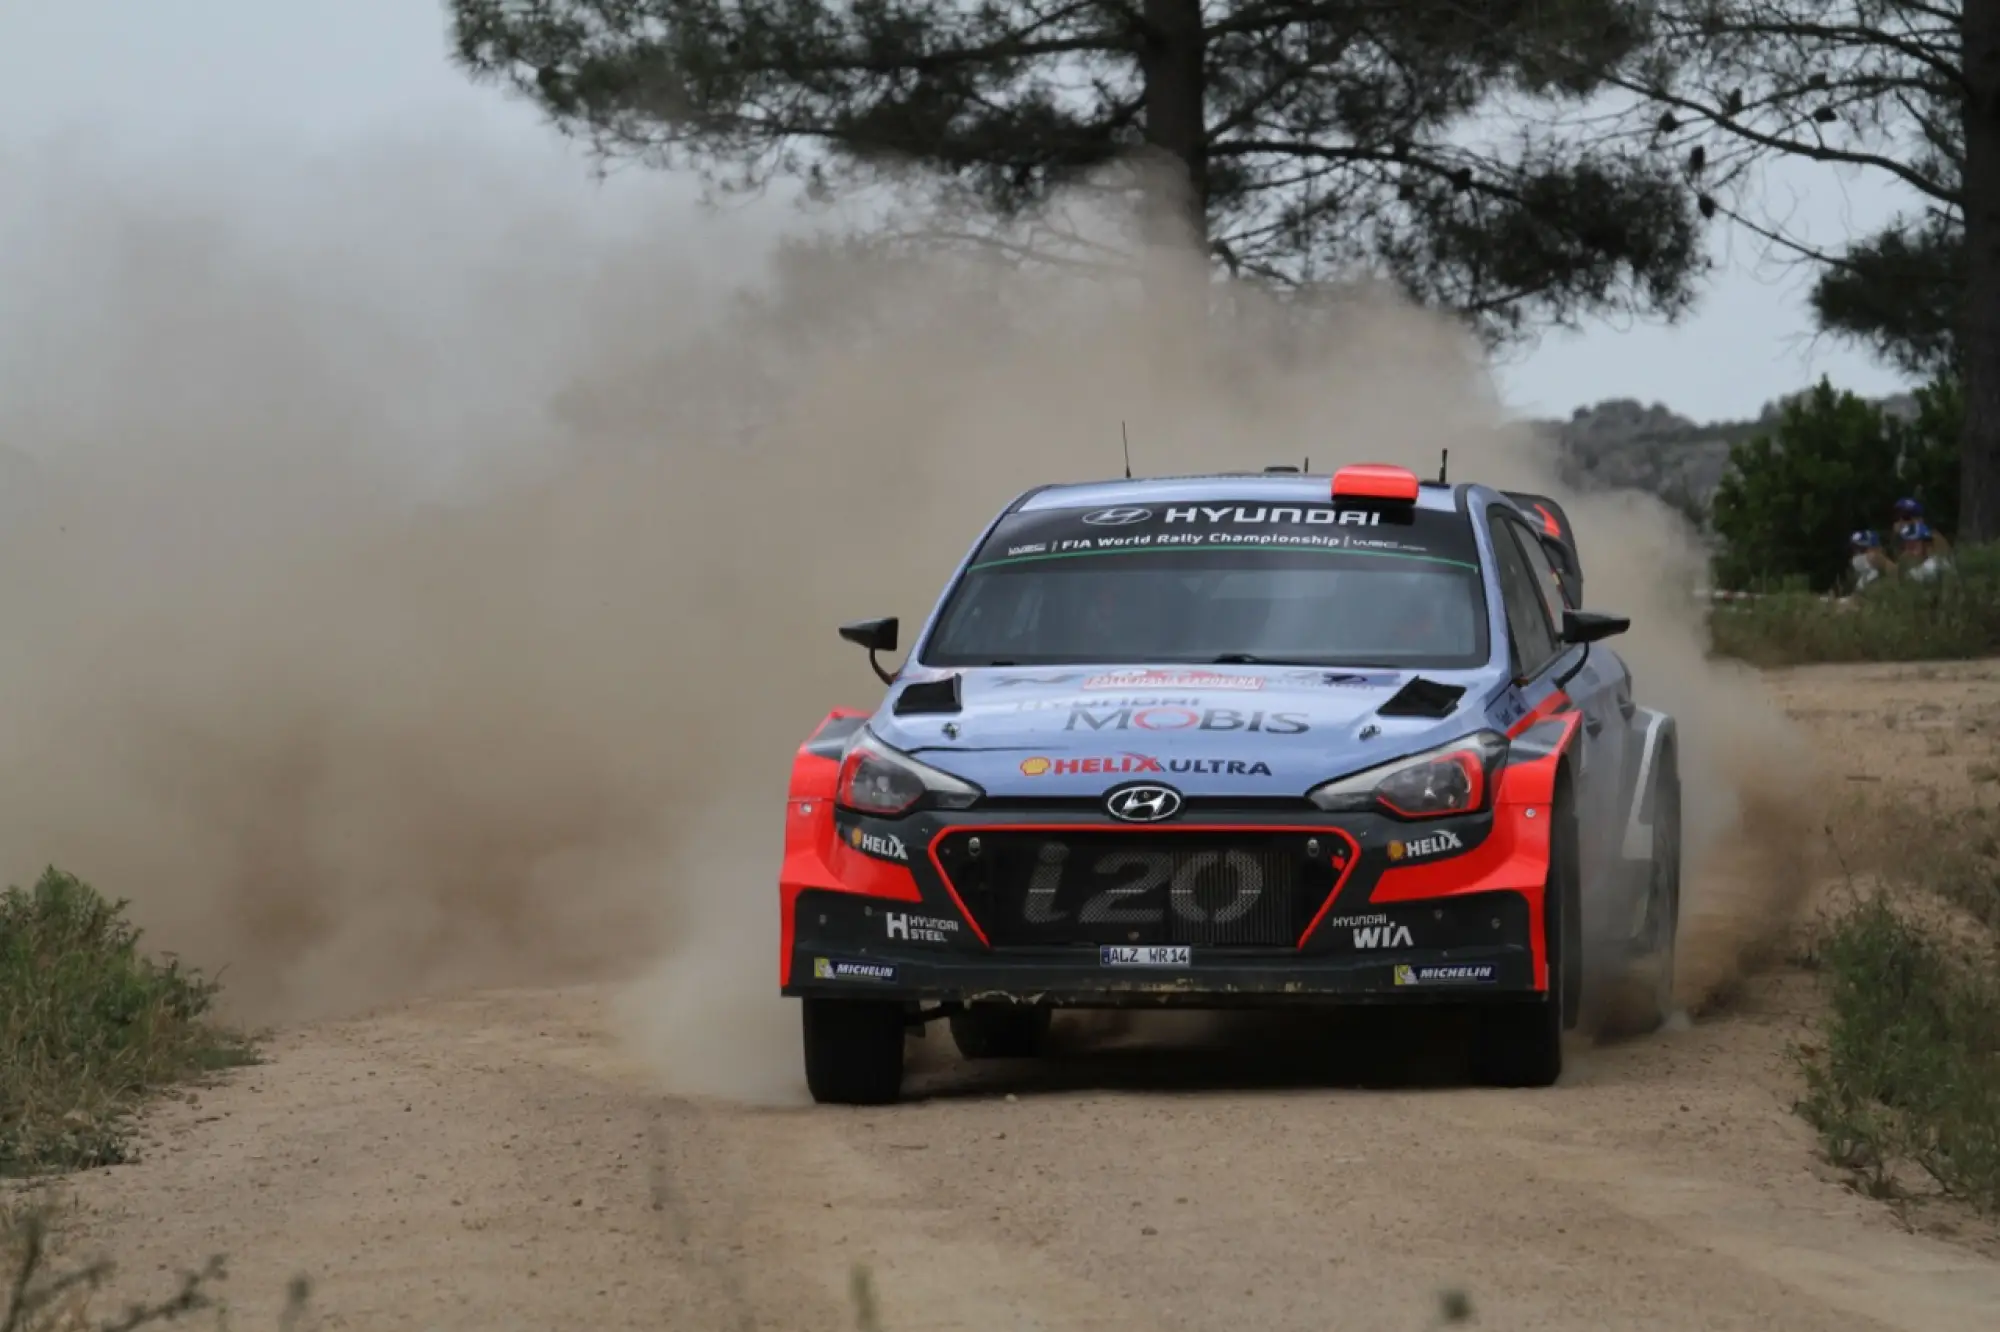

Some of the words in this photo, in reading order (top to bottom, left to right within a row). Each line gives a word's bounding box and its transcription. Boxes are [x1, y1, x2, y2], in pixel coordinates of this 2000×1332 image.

[1164, 506, 1381, 526] HYUNDAI
[1061, 539, 1092, 550] FIA
[1097, 534, 1152, 548] World
[1156, 533, 1204, 545] Rally
[1208, 532, 1341, 548] Championship
[1063, 706, 1311, 735] MOBIS
[1053, 751, 1166, 774] HELIX
[1168, 760, 1273, 777] ULTRA
[861, 833, 909, 860] HELIX
[1405, 829, 1463, 858] HELIX
[909, 915, 960, 932] HYUNDAI
[1331, 912, 1388, 928] HYUNDAI
[910, 929, 949, 943] STEEL
[1111, 948, 1139, 963] ALZ
[836, 963, 895, 978] MICHELIN
[1419, 966, 1493, 979] MICHELIN
